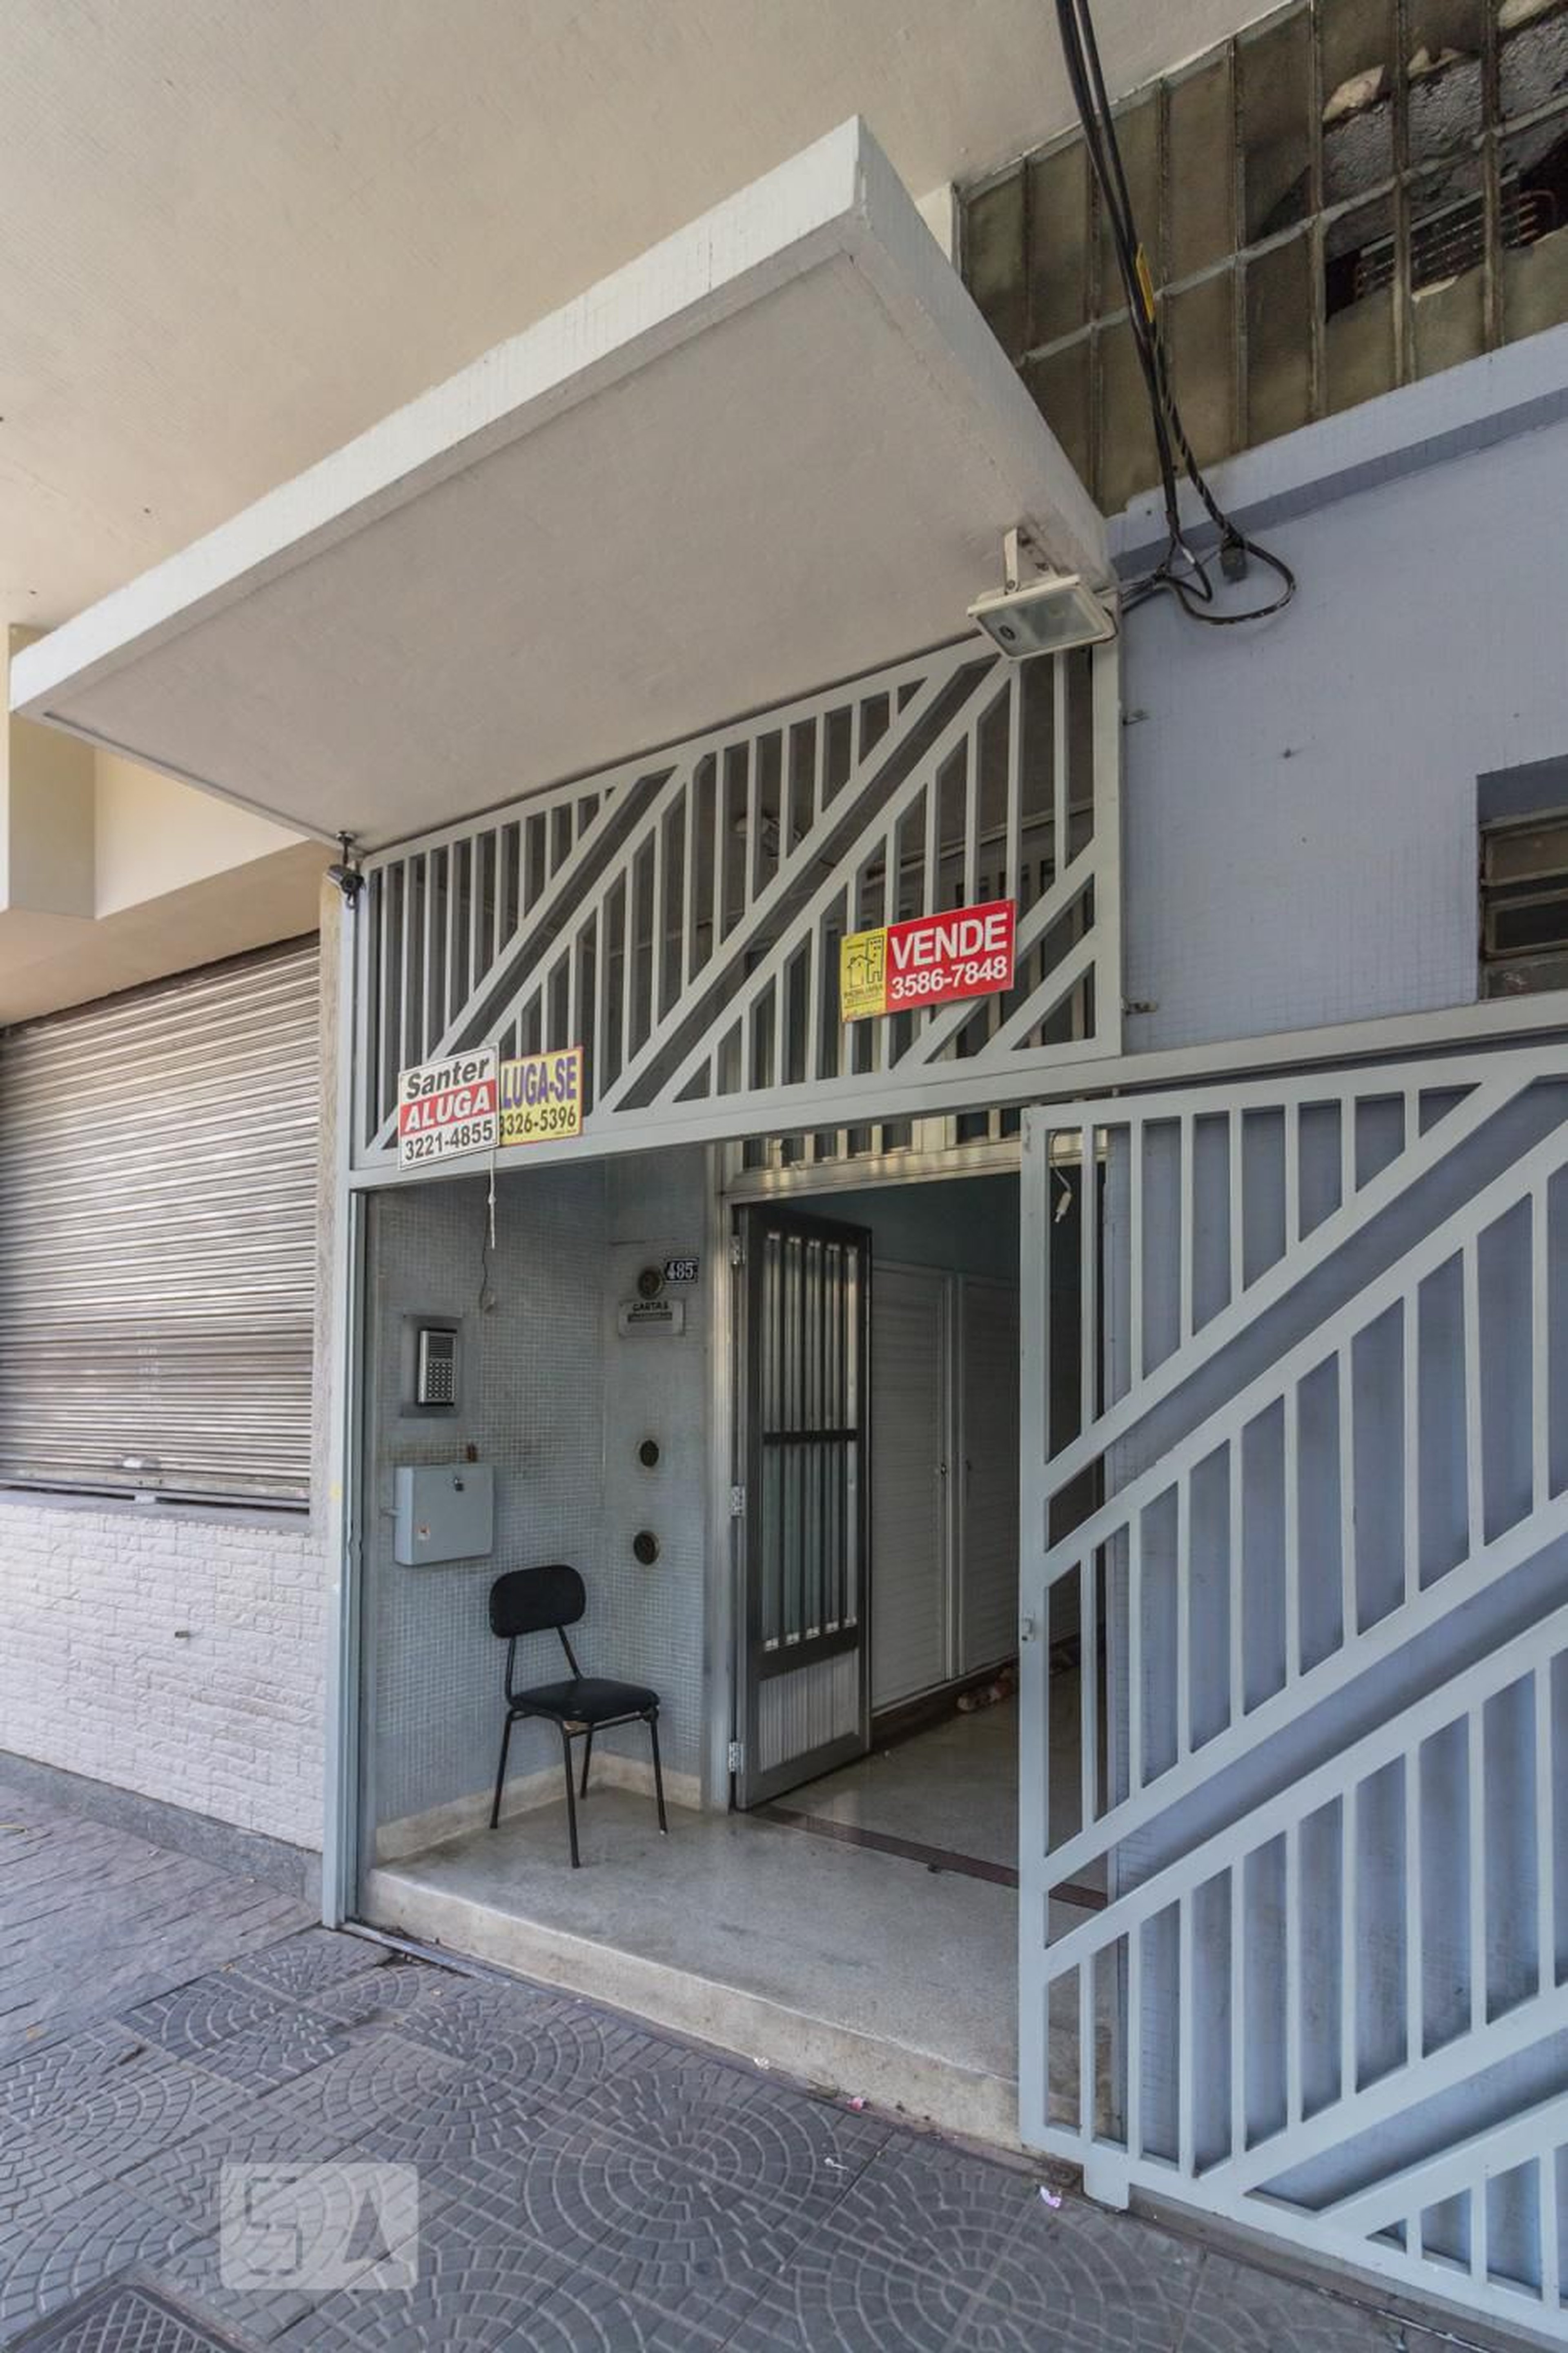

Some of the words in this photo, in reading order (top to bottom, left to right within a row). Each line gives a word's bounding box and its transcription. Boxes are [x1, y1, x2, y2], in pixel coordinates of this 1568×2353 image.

[891, 913, 1007, 969] VENDE
[891, 956, 1007, 999] 3586-7848
[406, 1057, 490, 1100] Santer
[502, 1056, 577, 1110] LUGA-SE
[405, 1086, 490, 1132] ALUGA
[405, 1120, 493, 1161] 3221-4855
[667, 1261, 694, 1280] 485
